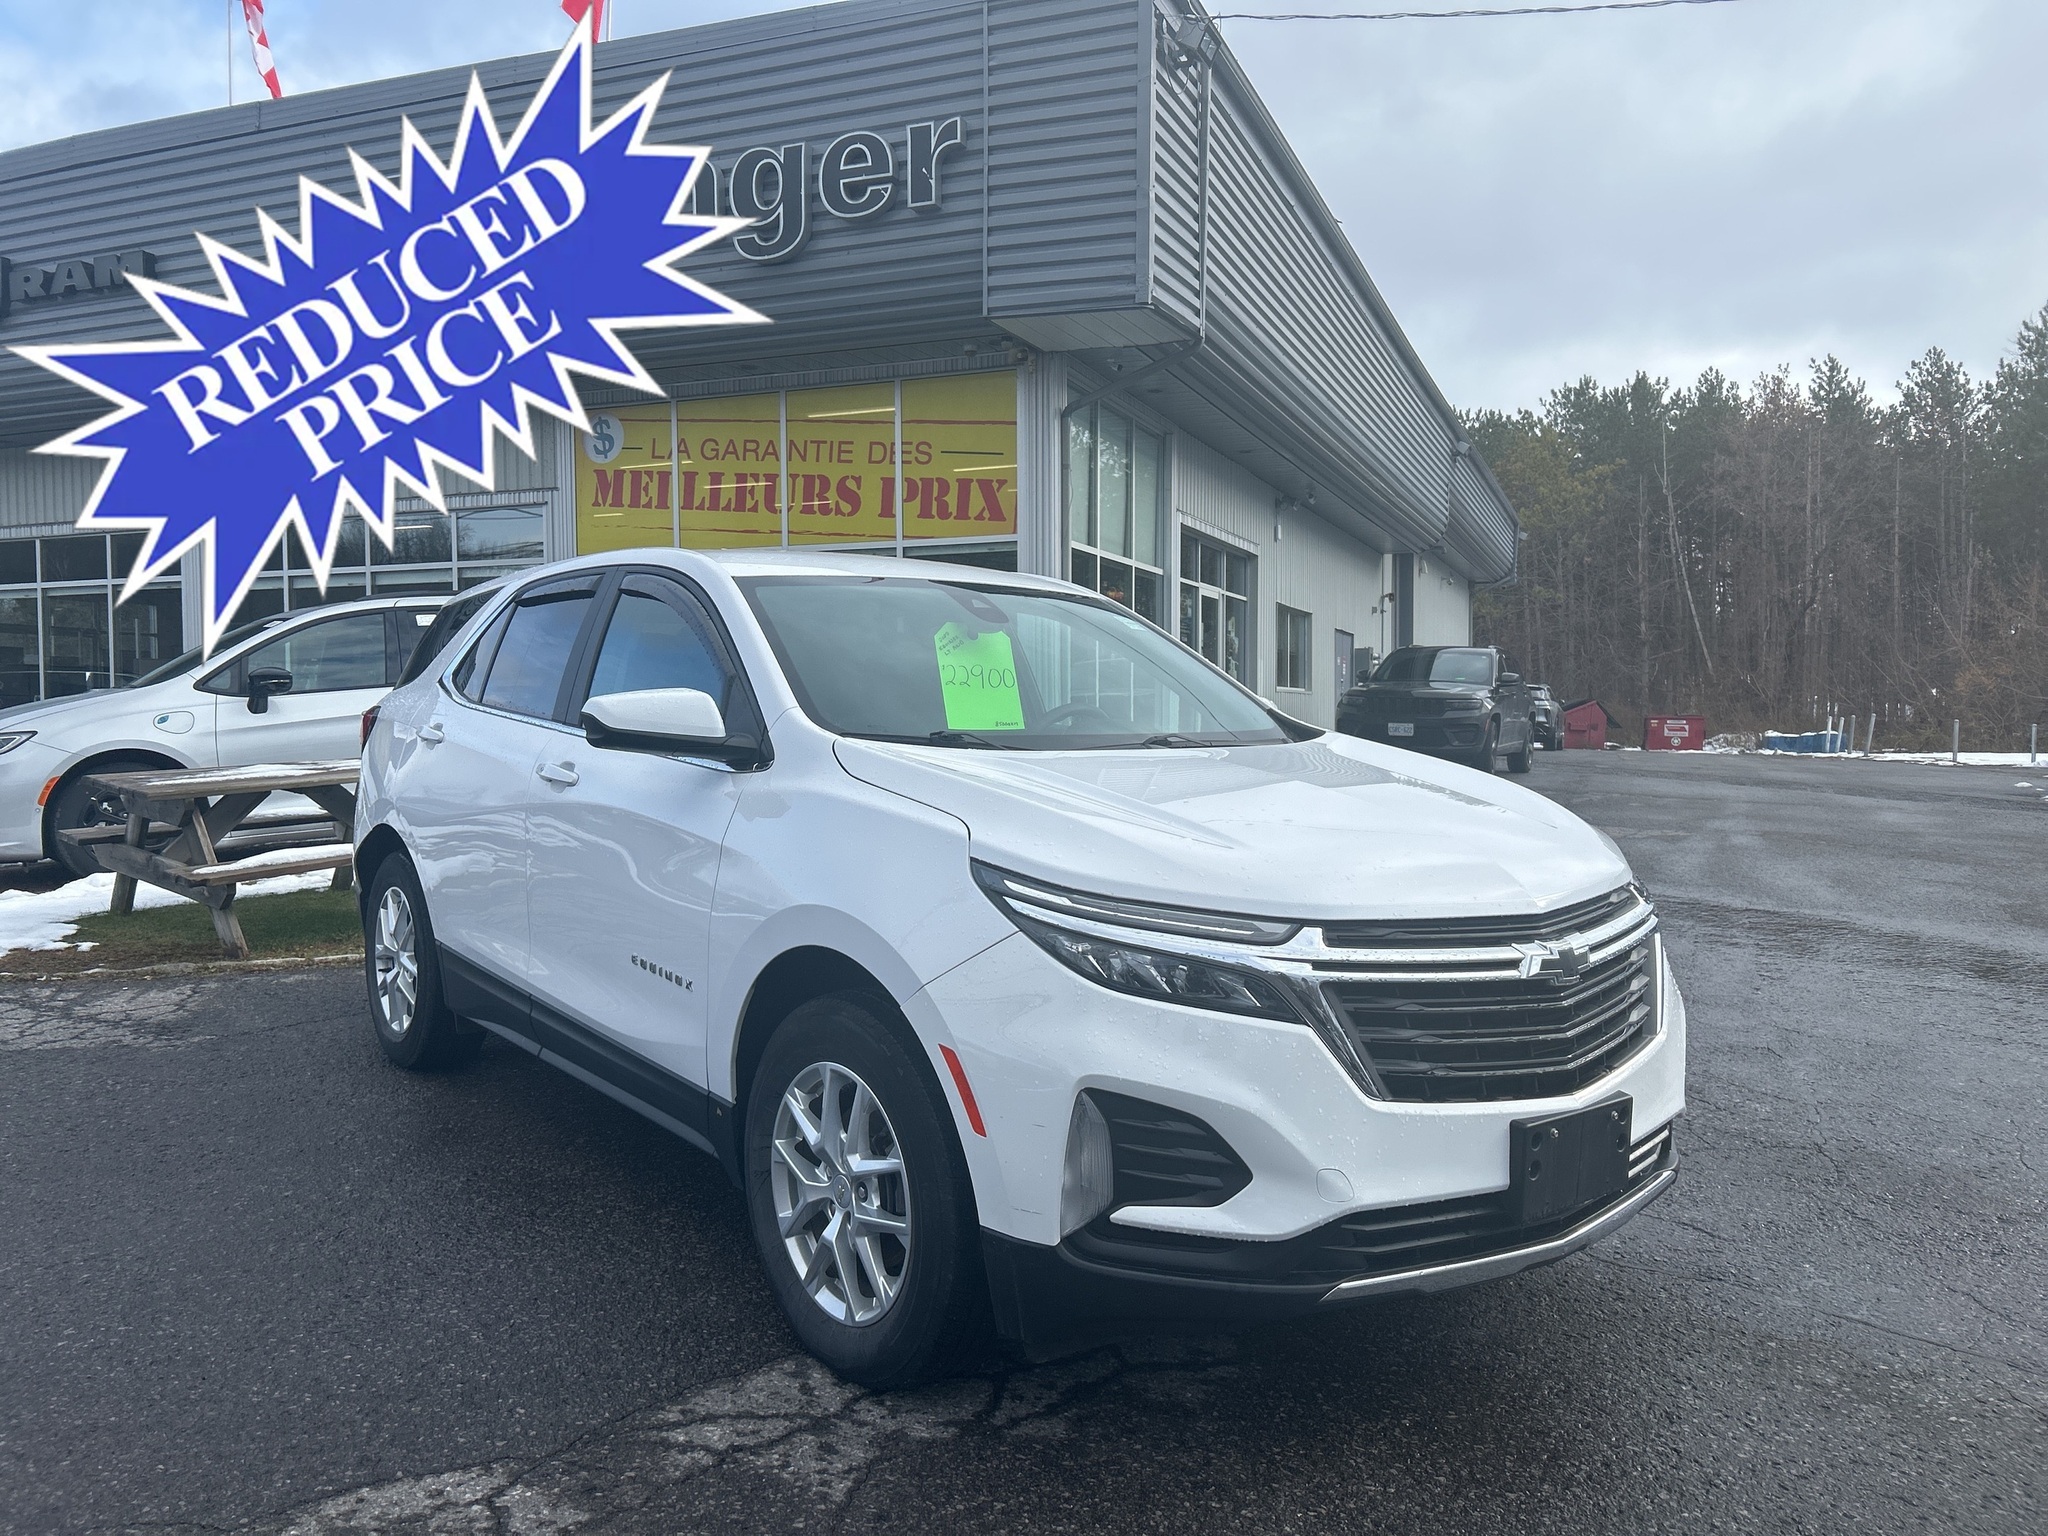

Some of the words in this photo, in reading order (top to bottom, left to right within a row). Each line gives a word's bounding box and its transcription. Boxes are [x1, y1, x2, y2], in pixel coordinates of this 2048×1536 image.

[8, 248, 148, 303] RAM
[650, 437, 691, 461] LA
[700, 438, 855, 464] GARANTIE
[867, 440, 934, 466] DES
[591, 468, 863, 518] MEILLEURS
[877, 475, 1008, 523] PRIX
[631, 952, 694, 993] EQUINOX
